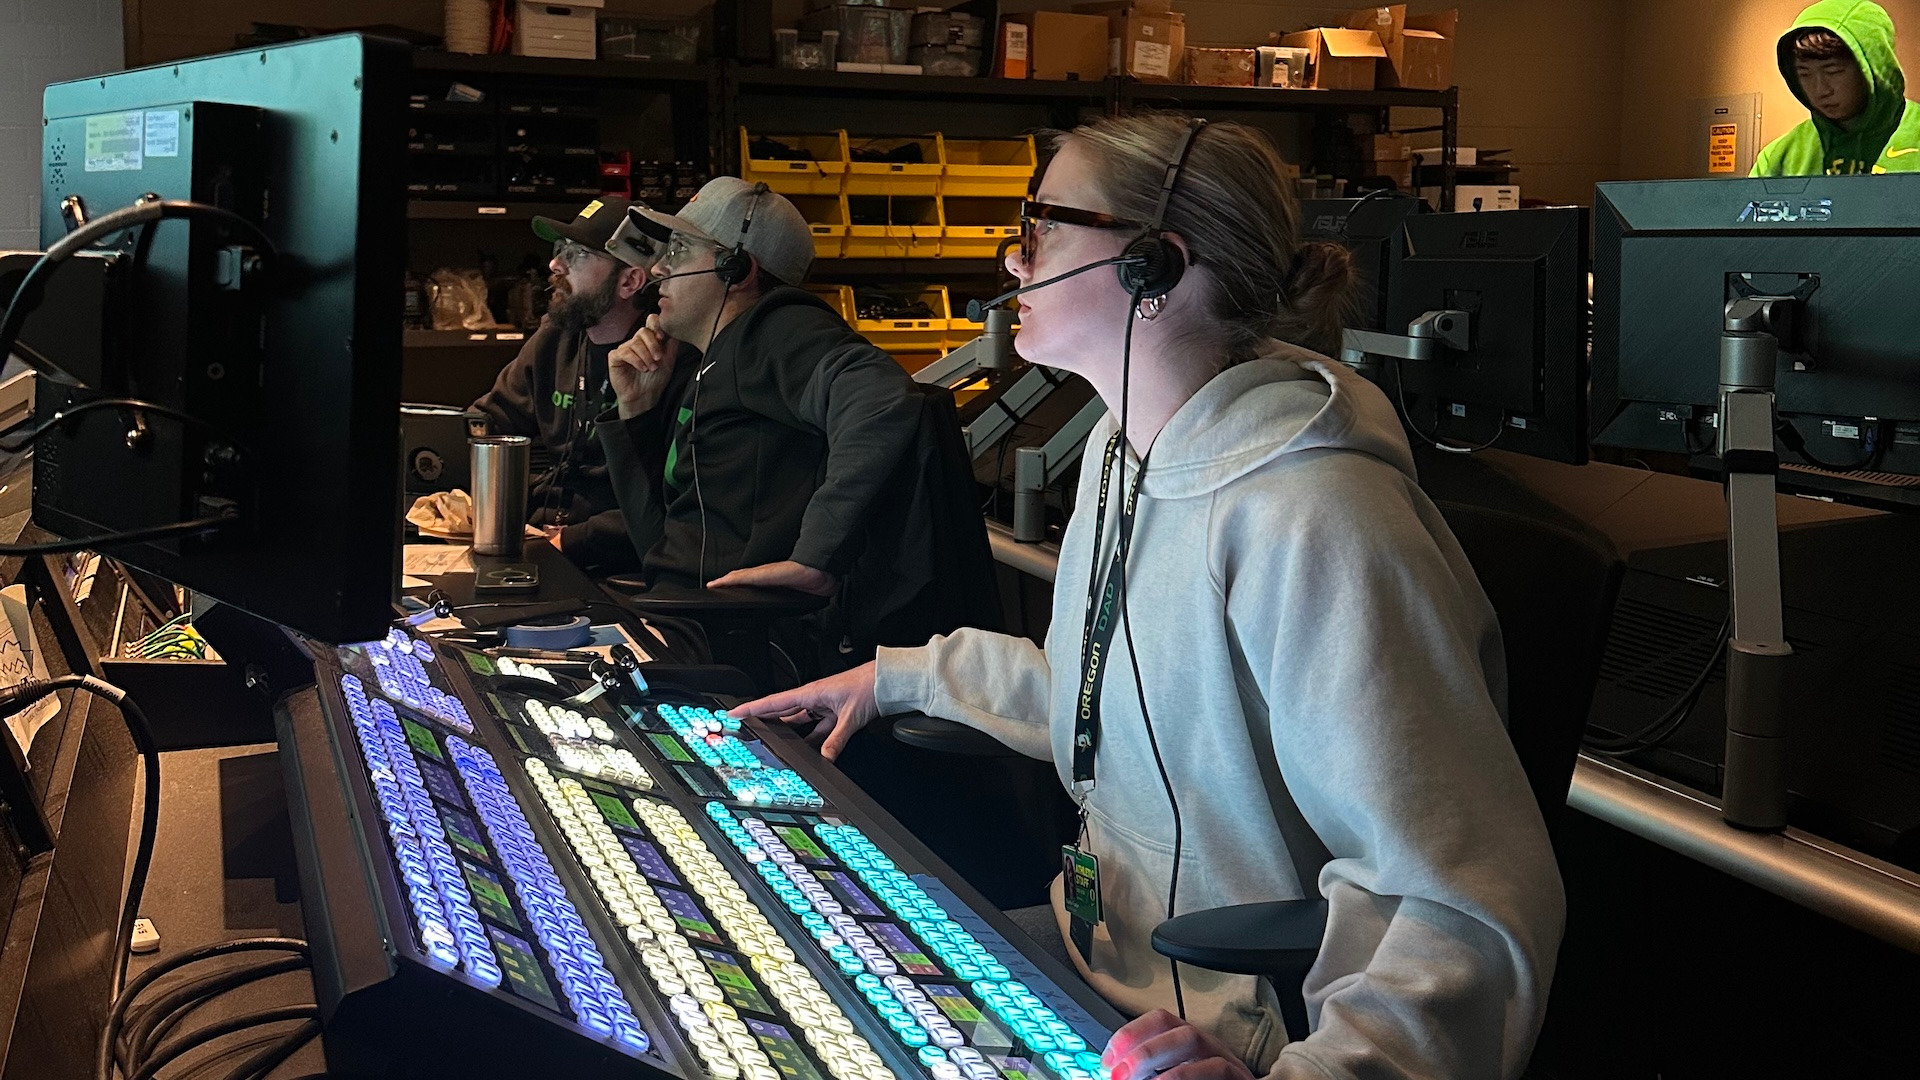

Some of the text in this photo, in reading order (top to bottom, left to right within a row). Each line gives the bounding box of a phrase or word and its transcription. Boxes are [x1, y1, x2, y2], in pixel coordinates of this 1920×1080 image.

[1736, 199, 1832, 223] ASUS
[1081, 641, 1101, 721] OREGON
[1097, 582, 1115, 632] DAD
